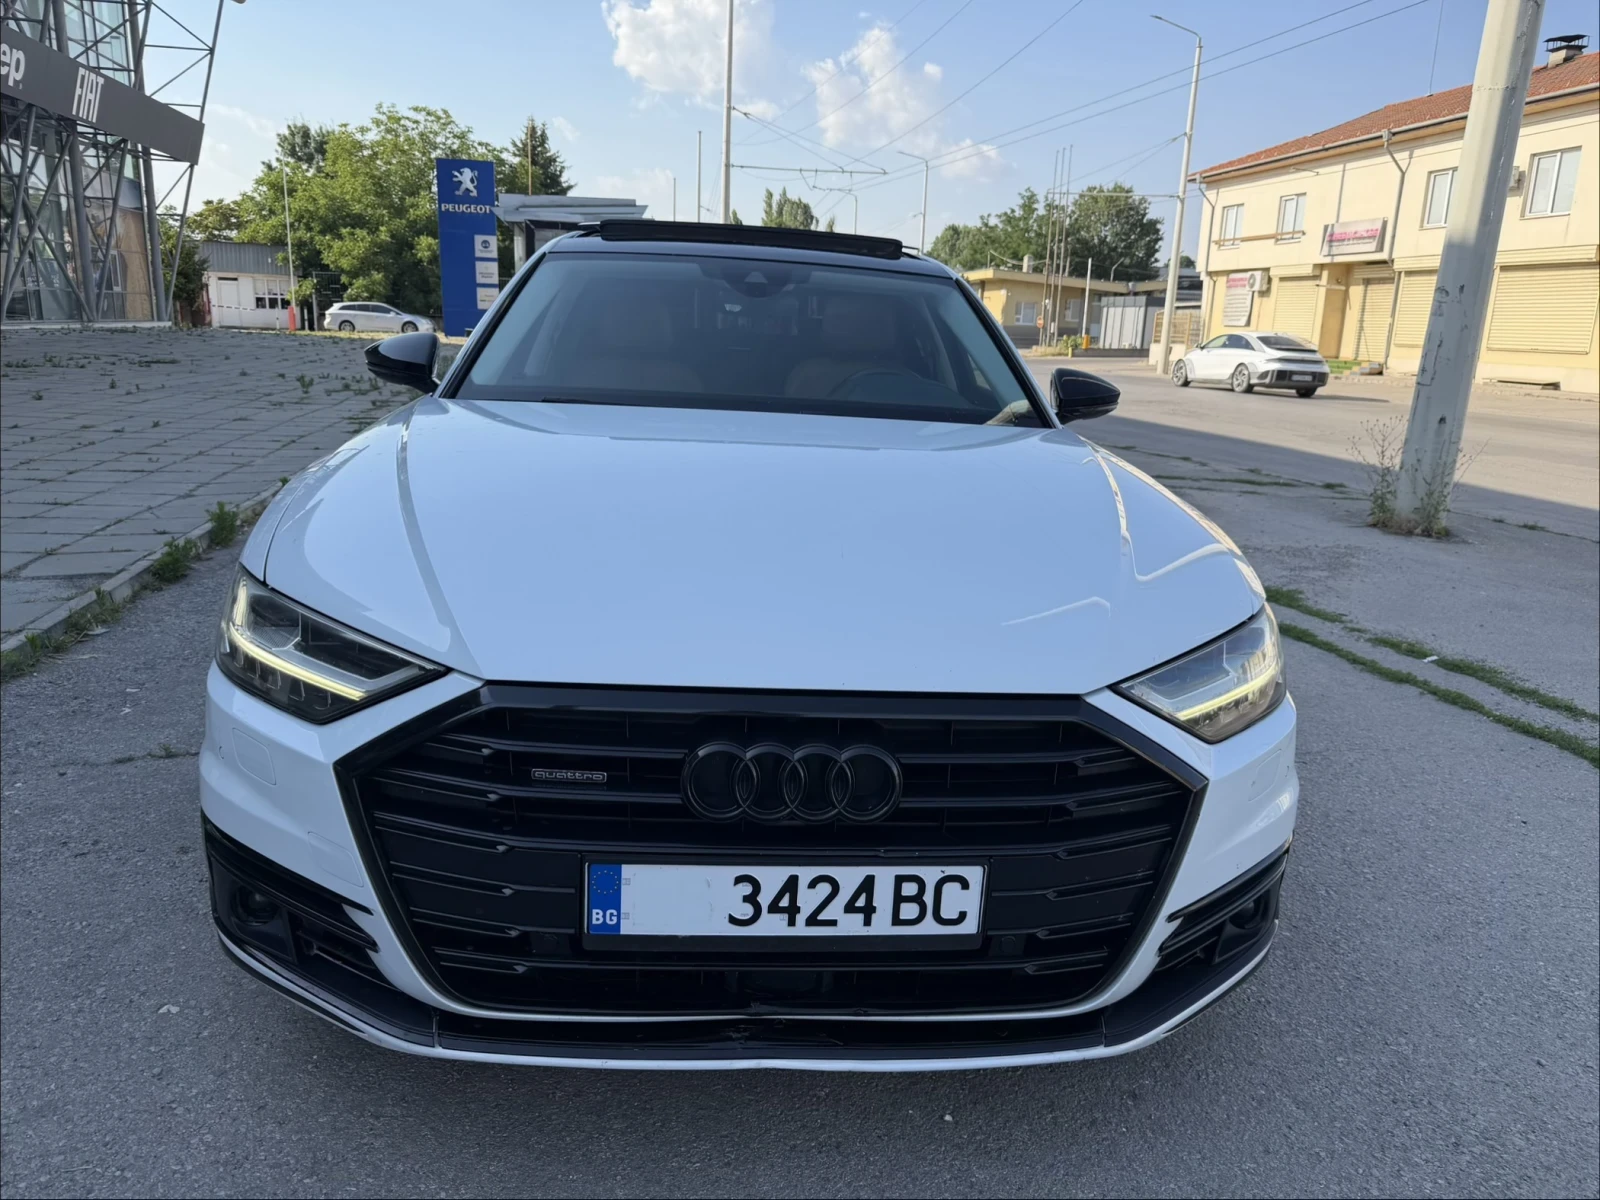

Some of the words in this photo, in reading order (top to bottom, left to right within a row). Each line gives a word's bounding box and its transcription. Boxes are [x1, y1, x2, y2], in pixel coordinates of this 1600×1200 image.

[72, 66, 105, 123] FIAT
[441, 203, 491, 214] PEUGEOT
[534, 771, 603, 780] quattro
[728, 874, 877, 927] 3424
[891, 874, 970, 927] BC
[592, 908, 618, 925] BG
